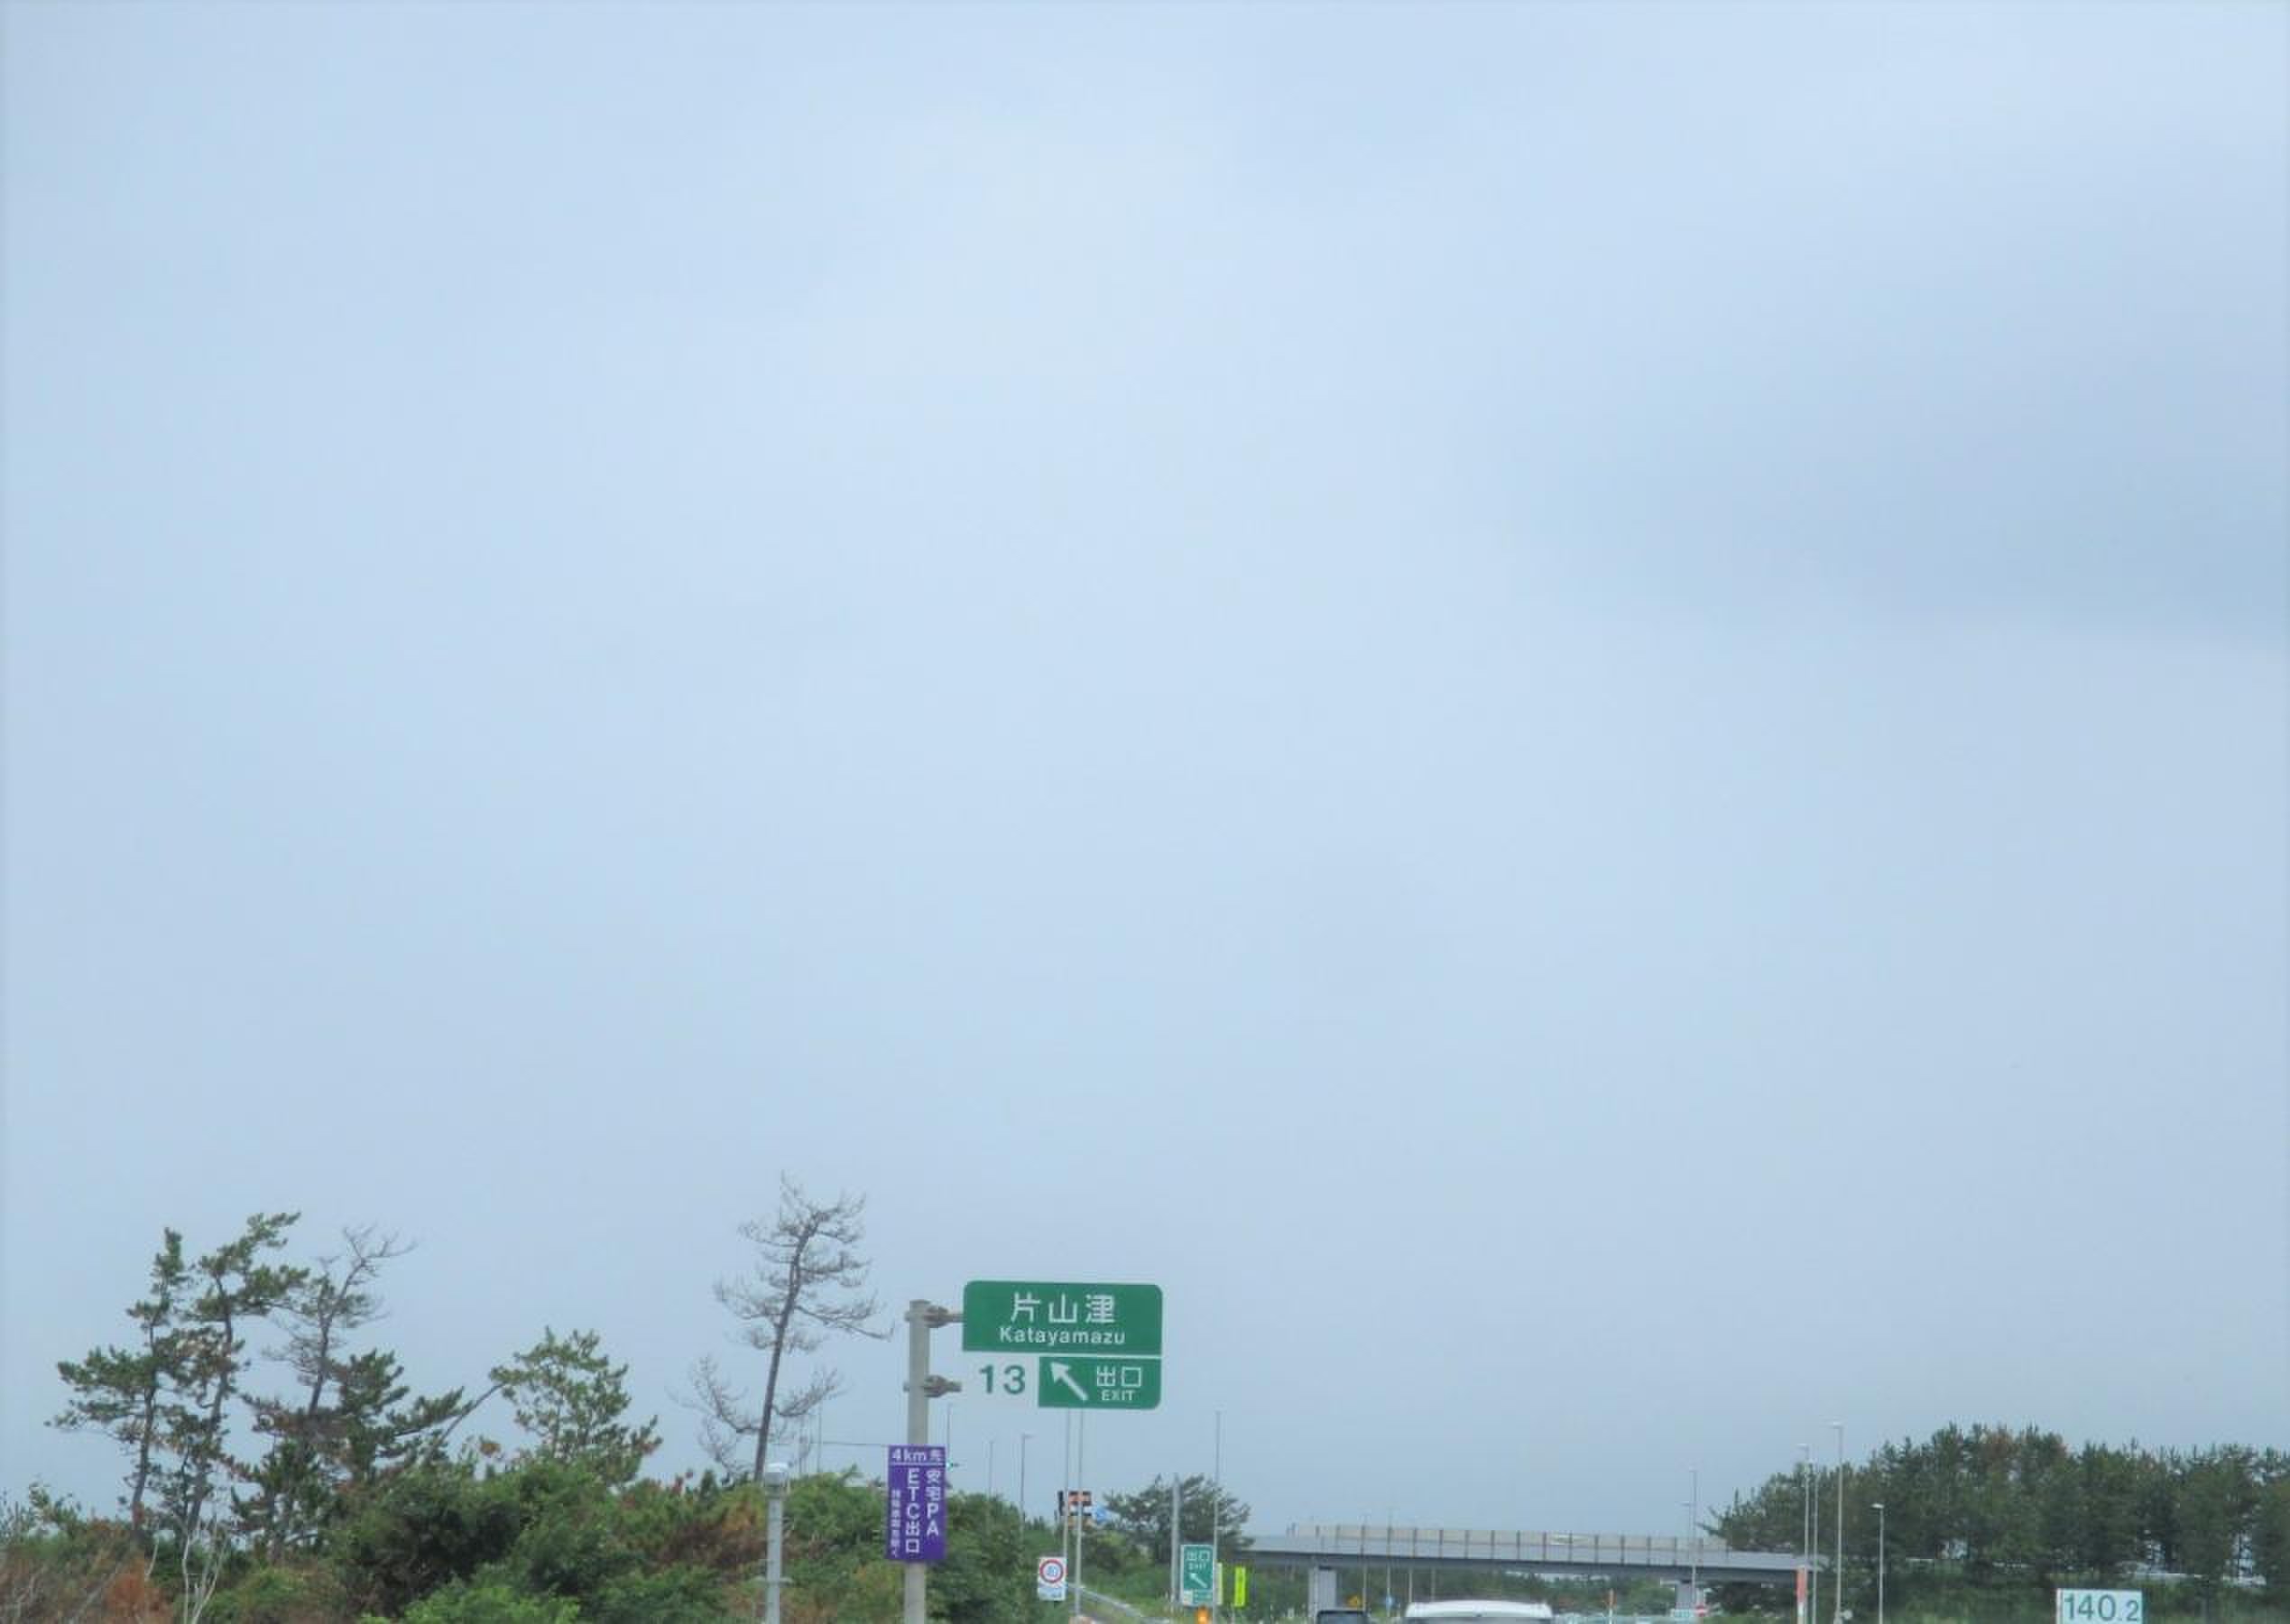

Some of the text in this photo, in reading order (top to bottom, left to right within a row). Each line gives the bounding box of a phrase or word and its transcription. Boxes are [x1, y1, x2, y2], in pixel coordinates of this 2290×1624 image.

[1010, 1291, 1115, 1324] 片山津
[999, 1326, 1126, 1347] Katayamazu
[979, 1364, 1026, 1395] 13
[1095, 1365, 1142, 1388] 出口
[1101, 1389, 1136, 1401] EXIT
[905, 1468, 920, 1554] ETC出口
[2063, 1593, 2140, 1622] 140.2
